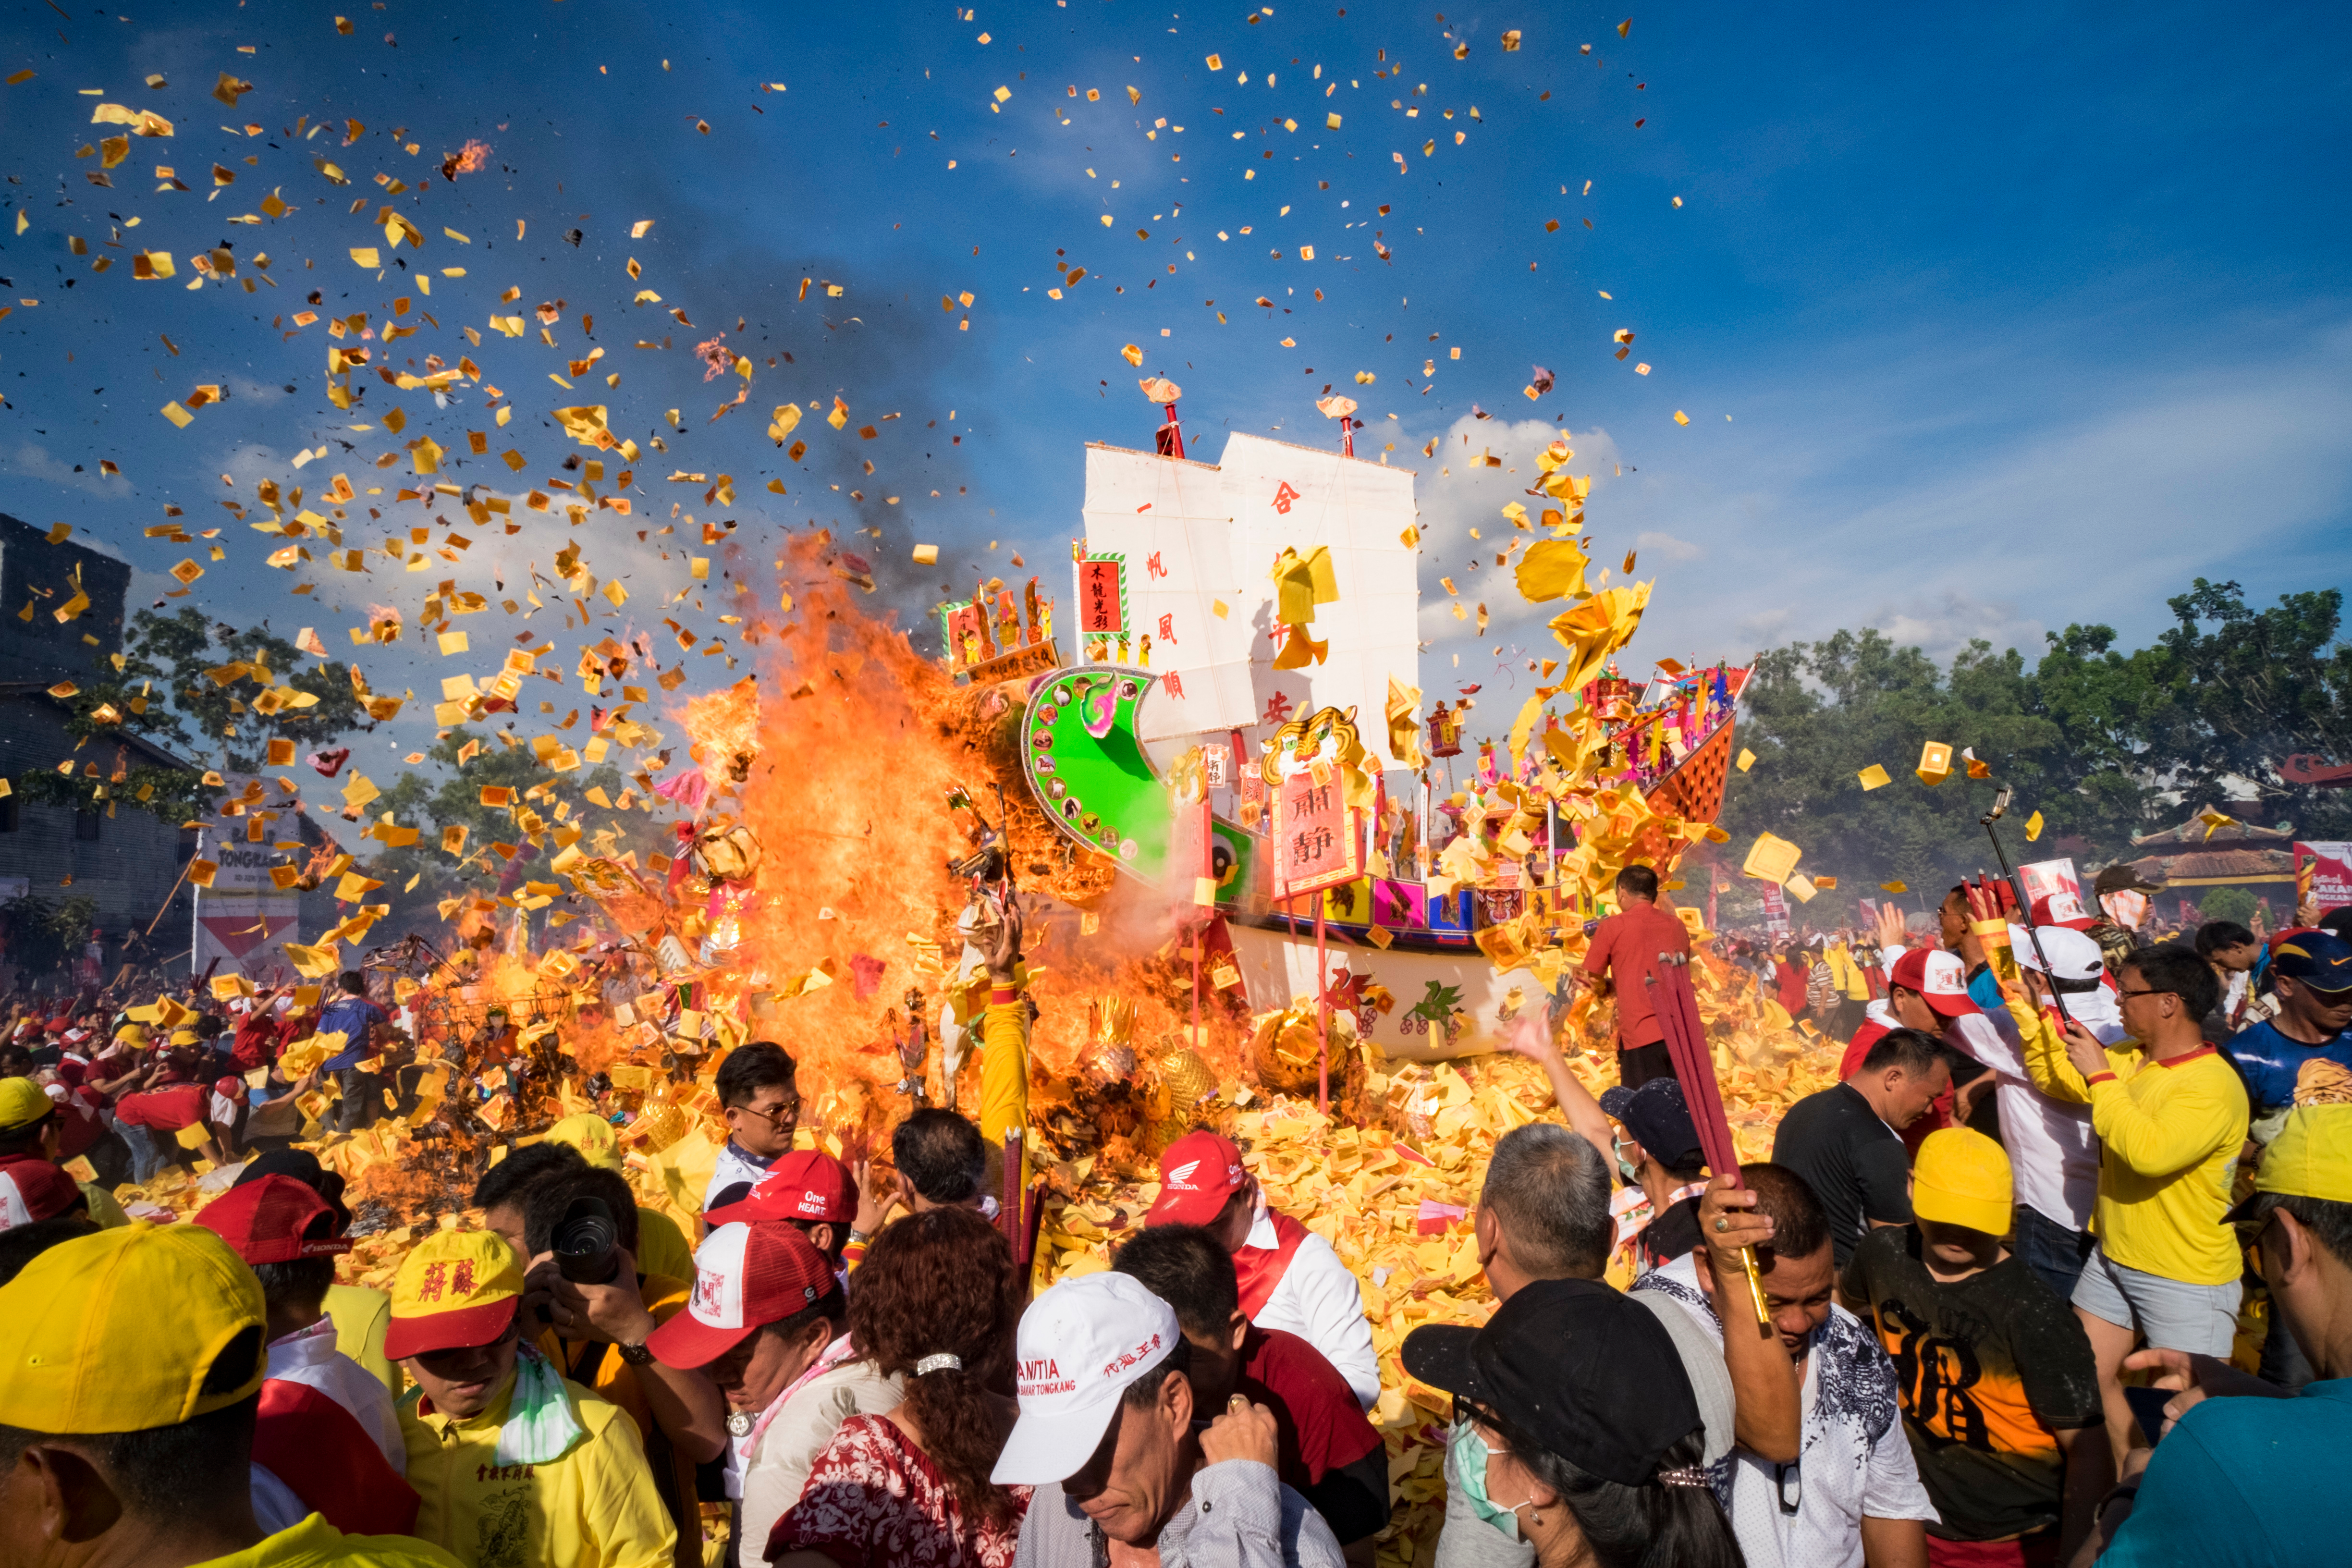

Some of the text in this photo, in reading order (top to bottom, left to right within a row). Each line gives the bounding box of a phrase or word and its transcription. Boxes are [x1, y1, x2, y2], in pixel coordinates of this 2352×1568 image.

[1137, 503, 1185, 700] 一帆風順
[805, 1191, 825, 1204] One
[1017, 1359, 1060, 1381] ANITIA
[1036, 1380, 1076, 1396] TONGKANG
